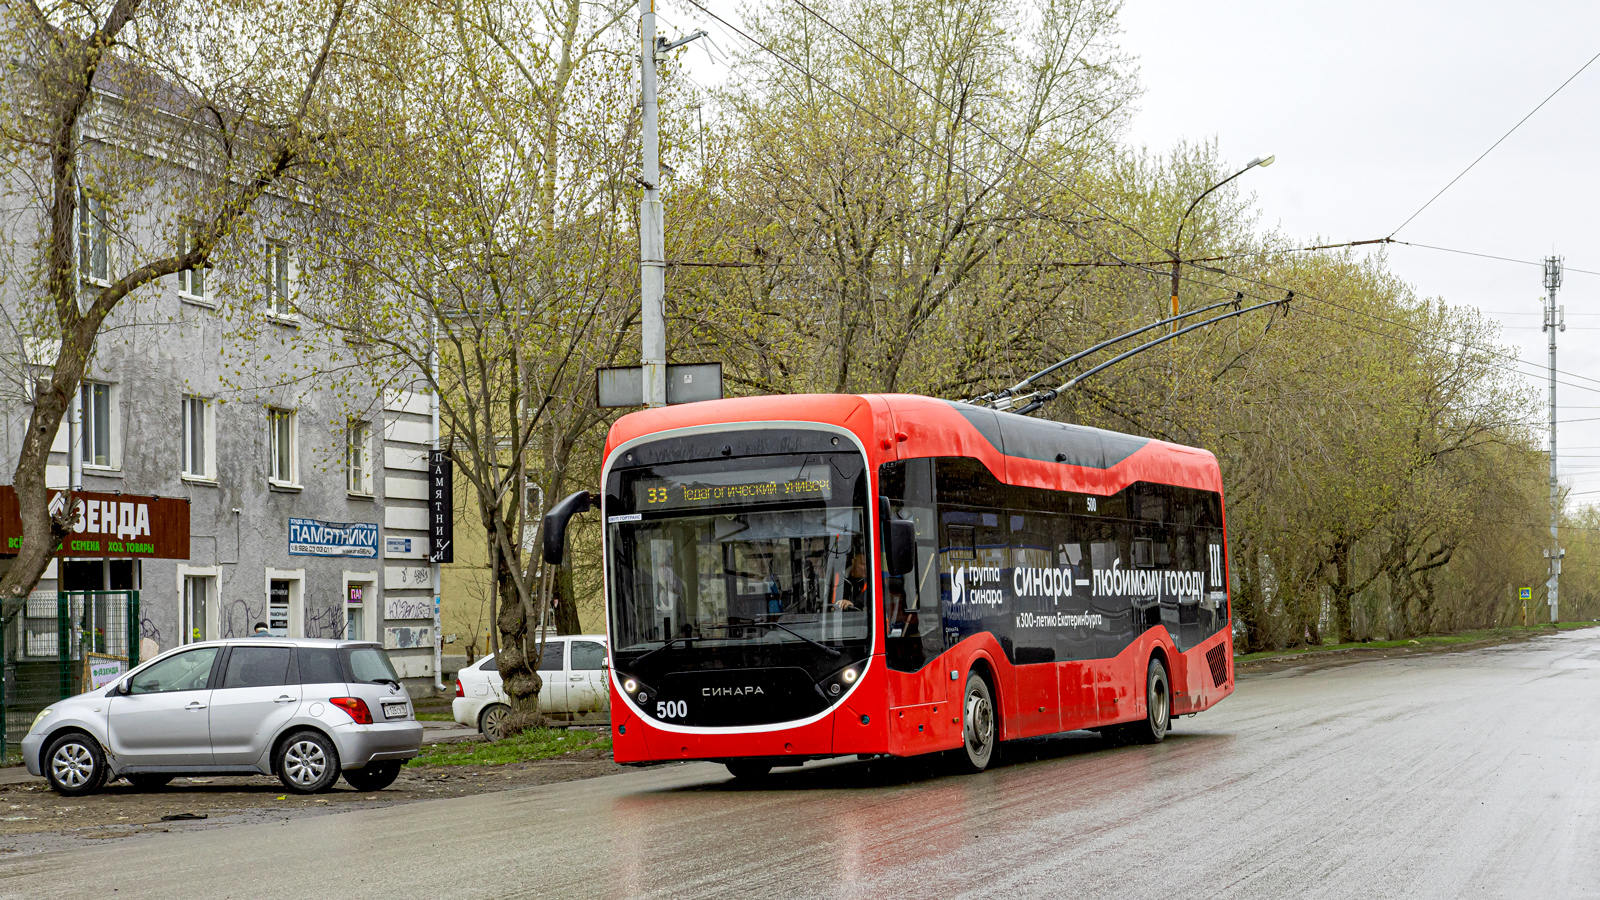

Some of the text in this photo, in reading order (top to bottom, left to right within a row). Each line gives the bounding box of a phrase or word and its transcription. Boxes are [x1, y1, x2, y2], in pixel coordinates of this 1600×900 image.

[647, 486, 668, 503] 33
[435, 452, 444, 561] ПАМЯТНИКИ
[1086, 497, 1097, 512] 500
[290, 524, 377, 546] ПАМЯТНИКИ
[71, 540, 100, 551] СЕМЕНА
[108, 542, 154, 554] ХОЗ. ТОВАРЫ
[969, 566, 1000, 585] группа
[1013, 566, 1072, 605] синара
[1092, 558, 1162, 603] любимому
[1165, 569, 1205, 604] городу
[970, 588, 1003, 608] синара
[1057, 612, 1102, 630] Екатеринбурга
[701, 685, 765, 697] СИНАРА
[656, 699, 688, 719] 500
